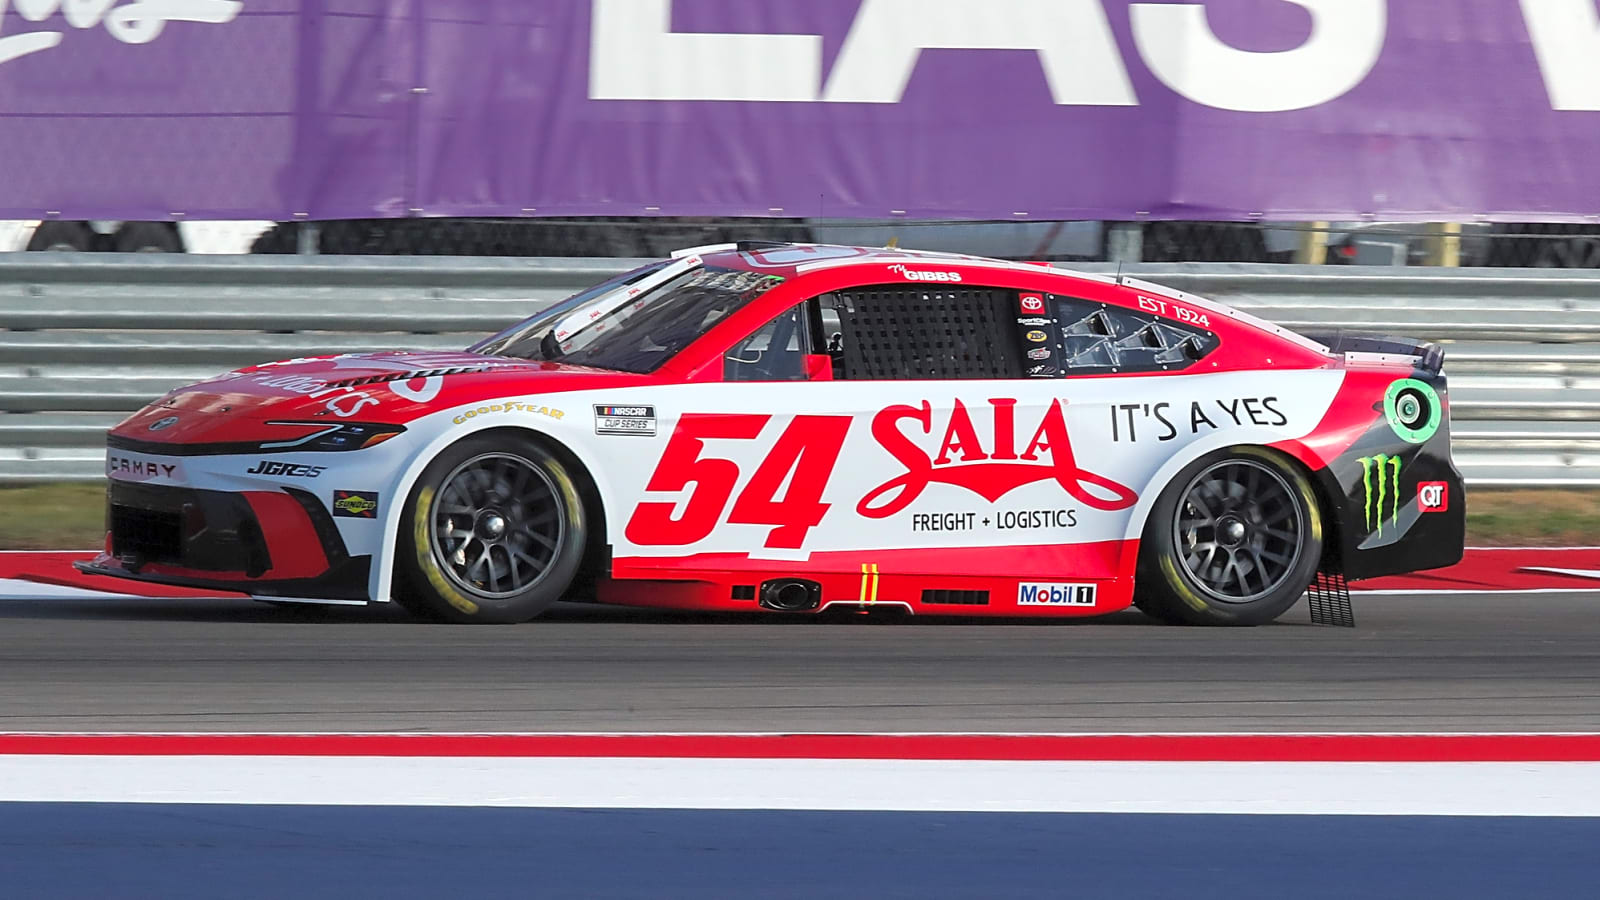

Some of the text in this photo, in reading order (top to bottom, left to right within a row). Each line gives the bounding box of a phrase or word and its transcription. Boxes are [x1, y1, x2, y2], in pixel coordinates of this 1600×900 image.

[905, 270, 962, 282] GIBBS
[1137, 295, 1210, 327] EST 1924
[453, 401, 565, 425] GOODYEAR
[615, 407, 647, 416] NASCAR
[1111, 397, 1288, 442] IT'S A YES
[604, 419, 648, 429] CUP SERIES
[111, 457, 176, 478] CAMRY
[856, 397, 1139, 519] SAIA
[625, 413, 854, 549] 54
[335, 499, 376, 510] SUNOCO
[1420, 485, 1443, 507] QT
[912, 512, 976, 531] FREIGHT
[997, 510, 1077, 529] LOGISTICS
[1020, 586, 1090, 603] Mobil 1
